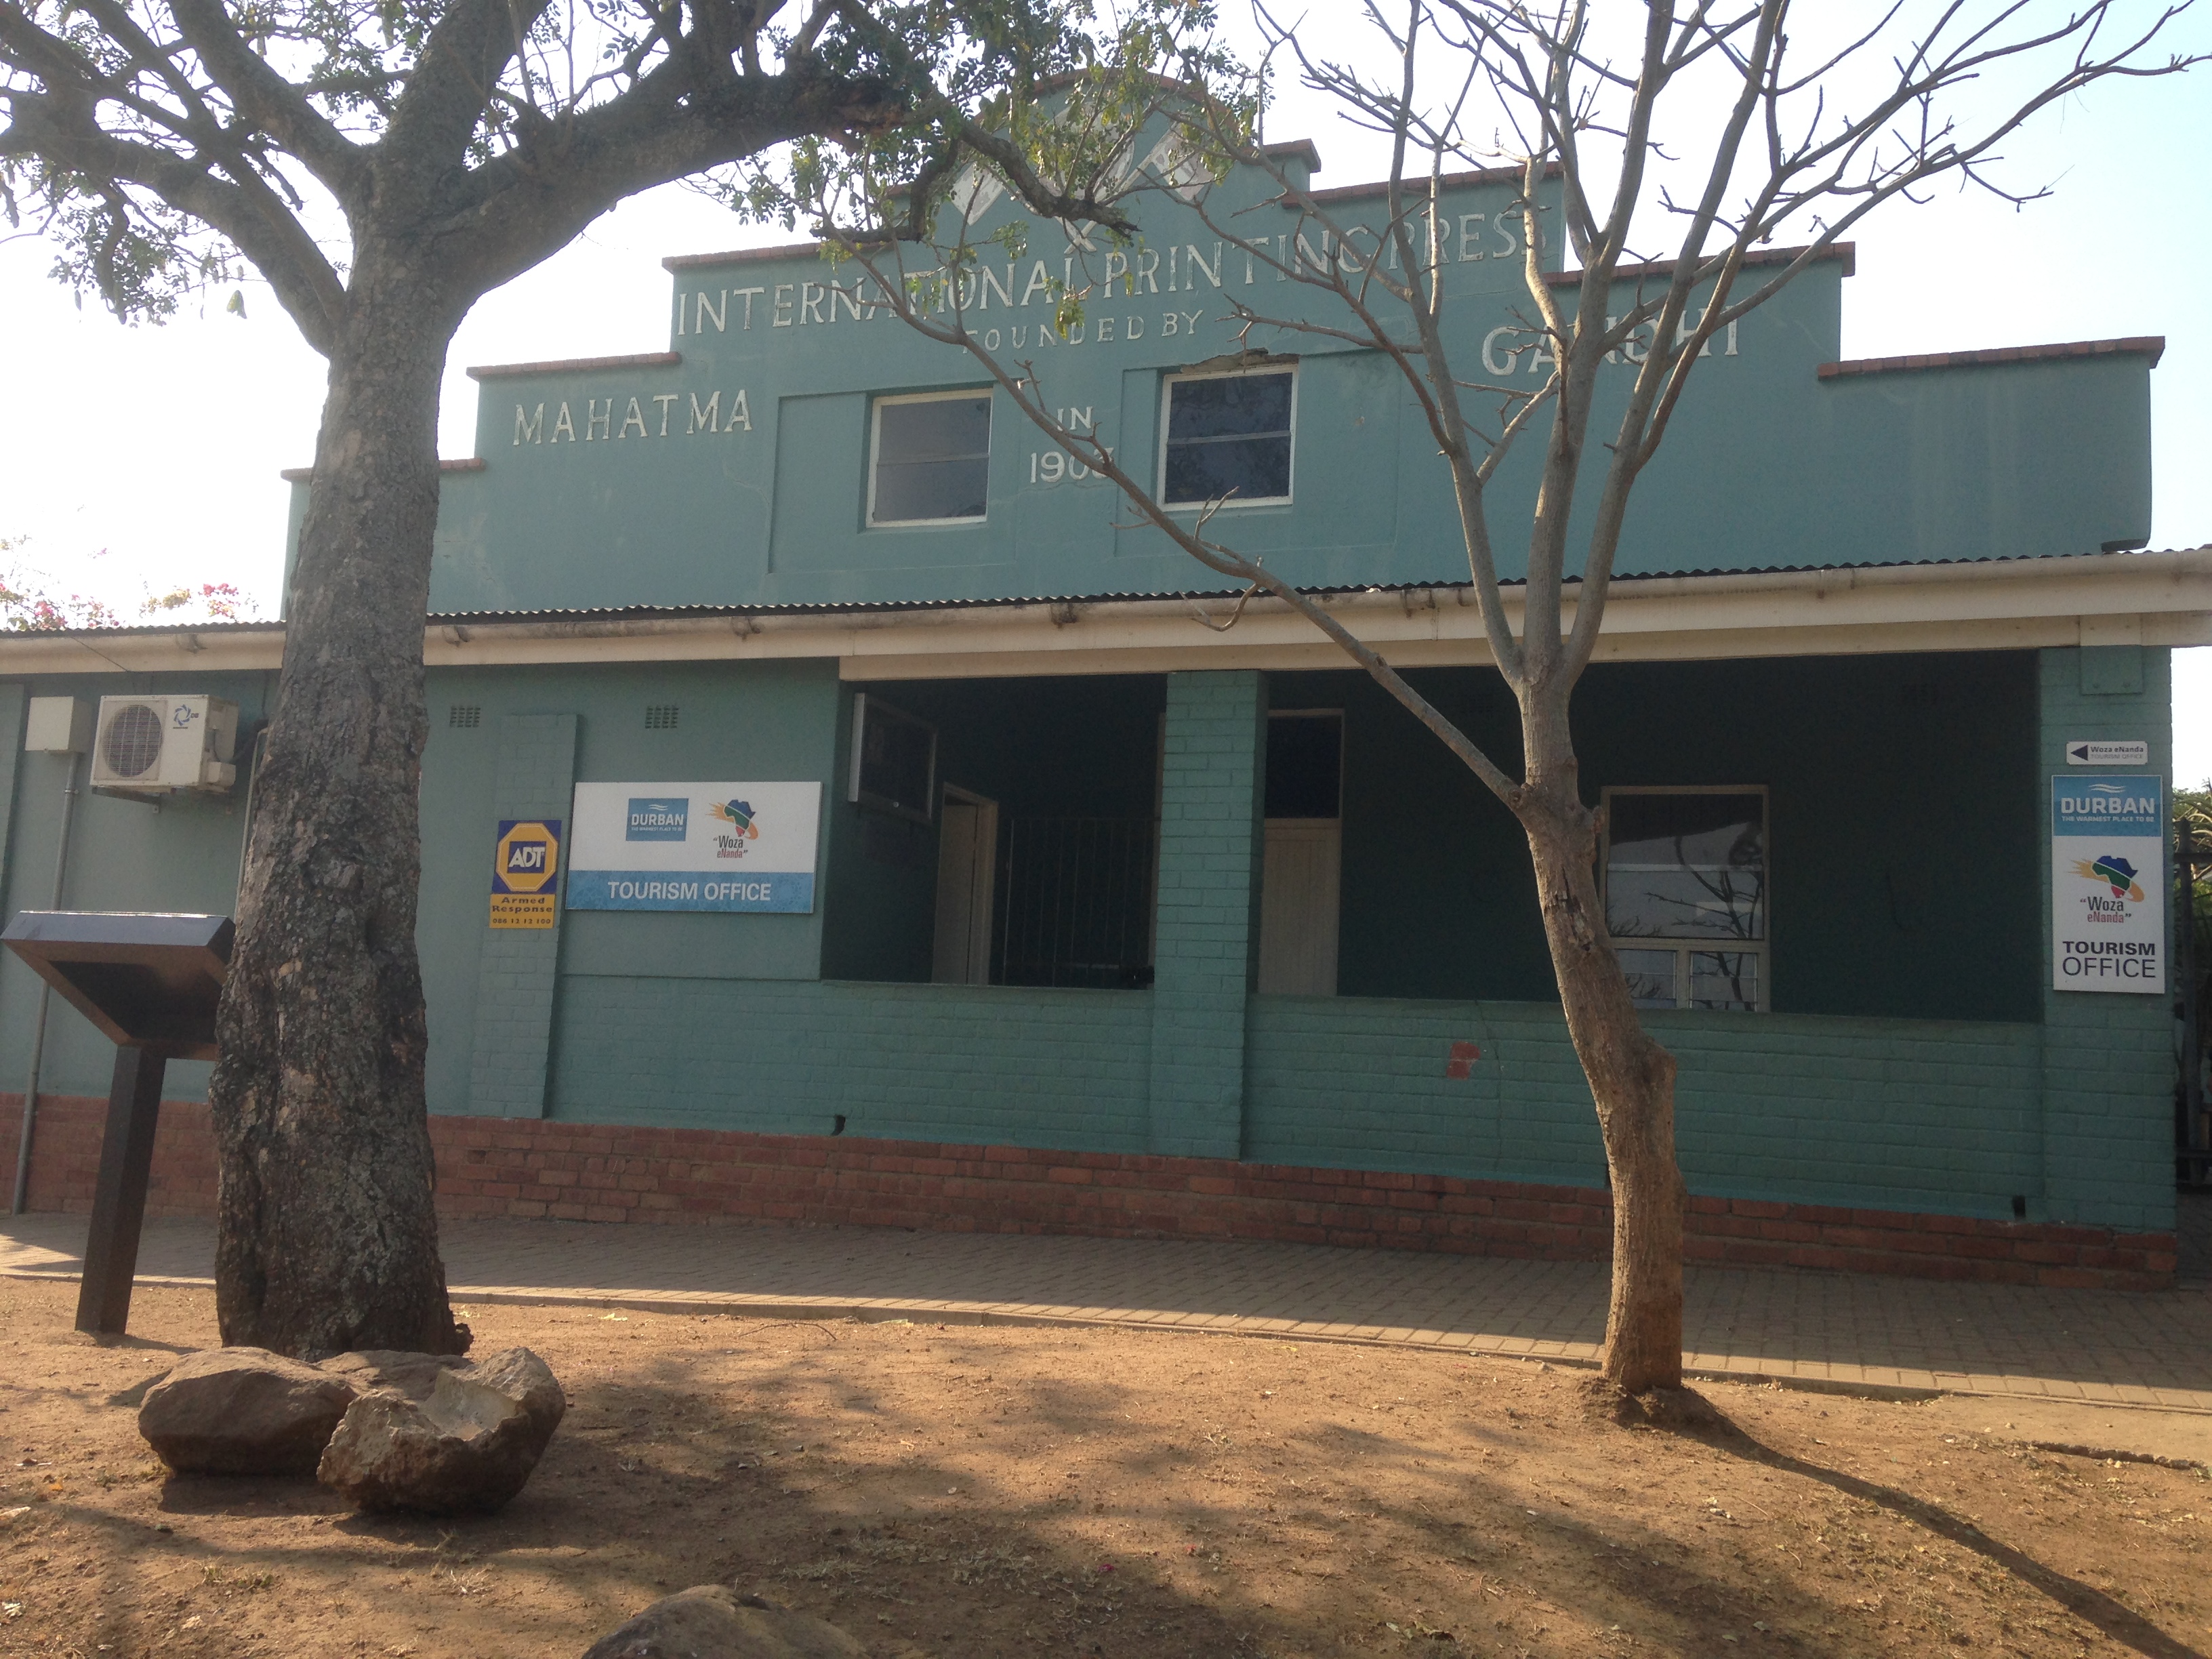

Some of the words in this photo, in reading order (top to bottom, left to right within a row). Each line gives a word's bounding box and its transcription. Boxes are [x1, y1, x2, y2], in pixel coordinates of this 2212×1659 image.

[677, 257, 1087, 336] INTERNATIONAL
[1103, 226, 1372, 299] PRINTING
[1388, 210, 1547, 270] PRES
[1161, 309, 1204, 337] BY
[513, 389, 753, 446] MAHATMA
[1057, 406, 1093, 431] IN
[2061, 798, 2154, 814] DURBAN
[632, 814, 684, 825] DURBAN
[508, 847, 546, 867] ADT
[608, 882, 698, 900] TOURISM
[703, 882, 771, 901] OFFICE
[492, 905, 552, 914] Response
[2062, 941, 2155, 956] TOURISM
[2062, 956, 2156, 978] OFFICE
